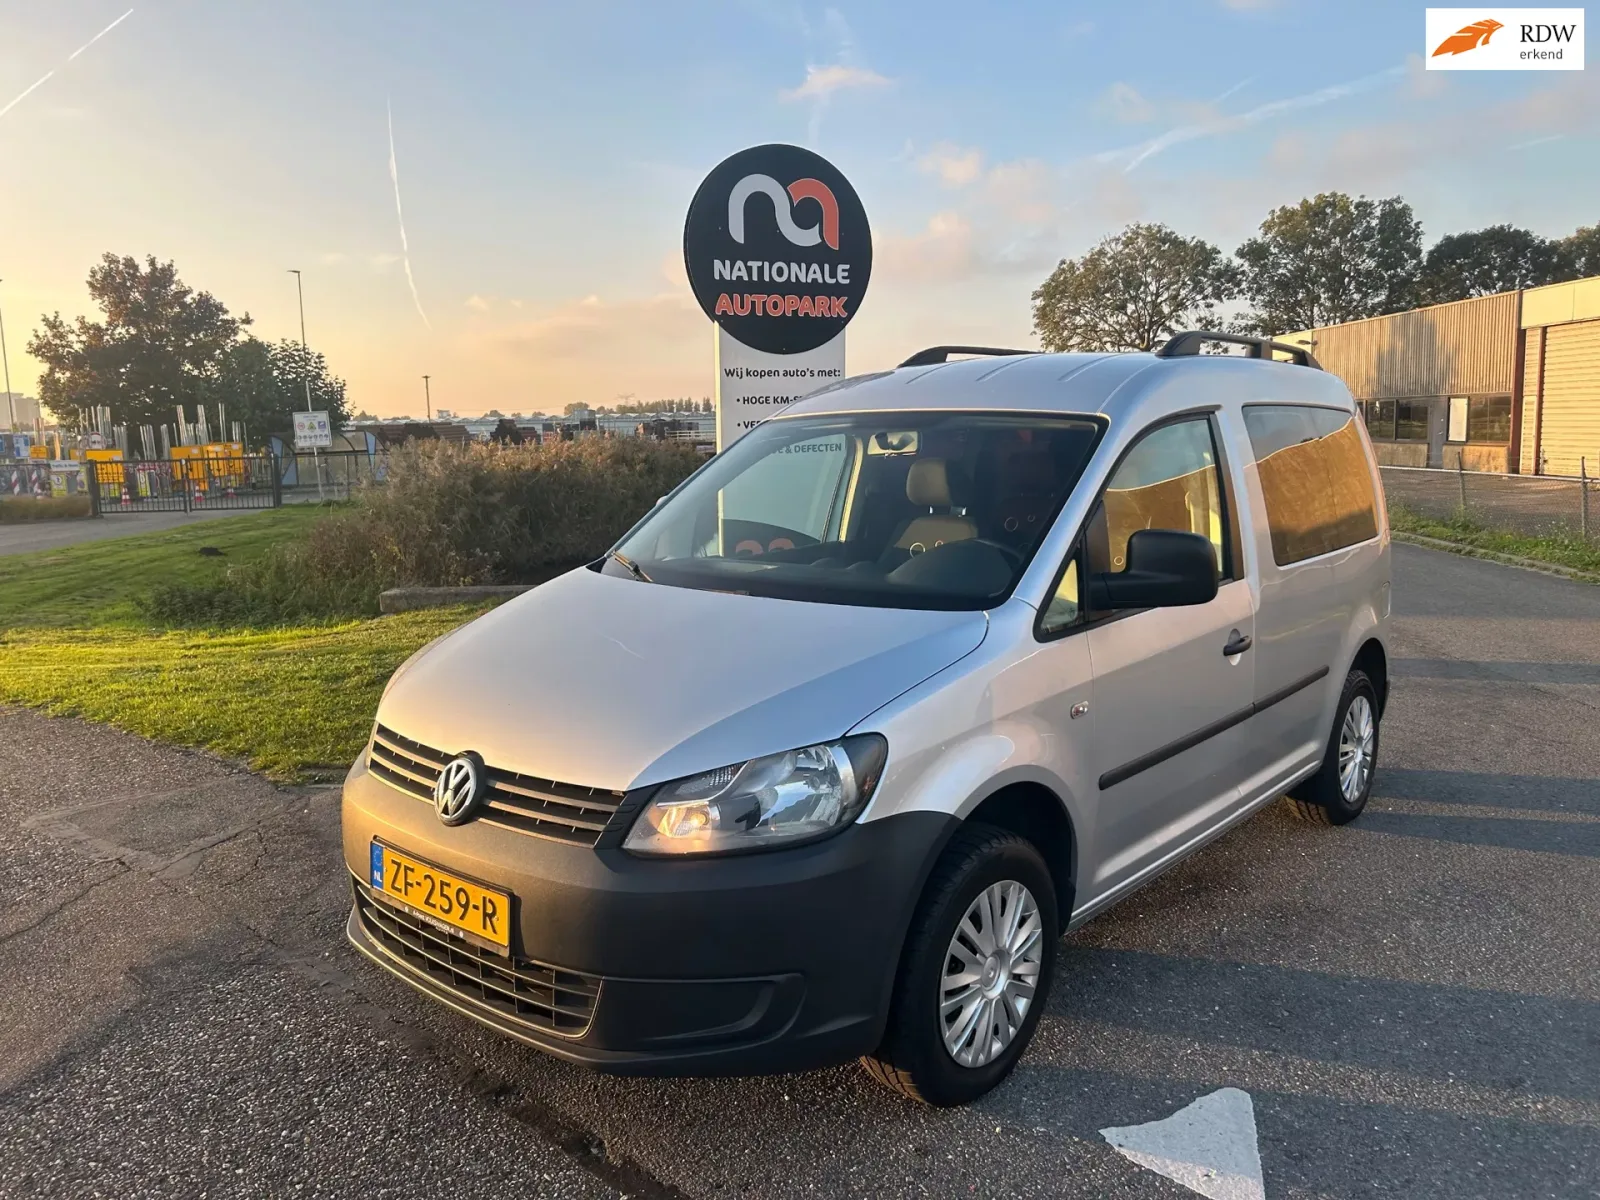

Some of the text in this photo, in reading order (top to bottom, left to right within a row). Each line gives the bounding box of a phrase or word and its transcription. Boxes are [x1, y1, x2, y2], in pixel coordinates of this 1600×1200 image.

[713, 259, 850, 284] NATIONALE
[715, 293, 848, 318] AUTOPARK
[724, 368, 841, 379] Wij kopen auto's met:
[742, 396, 803, 405] HOGE KM-S
[794, 443, 842, 453] DEFECTEN
[373, 870, 382, 882] NL
[390, 859, 498, 935] ZF-259-R
